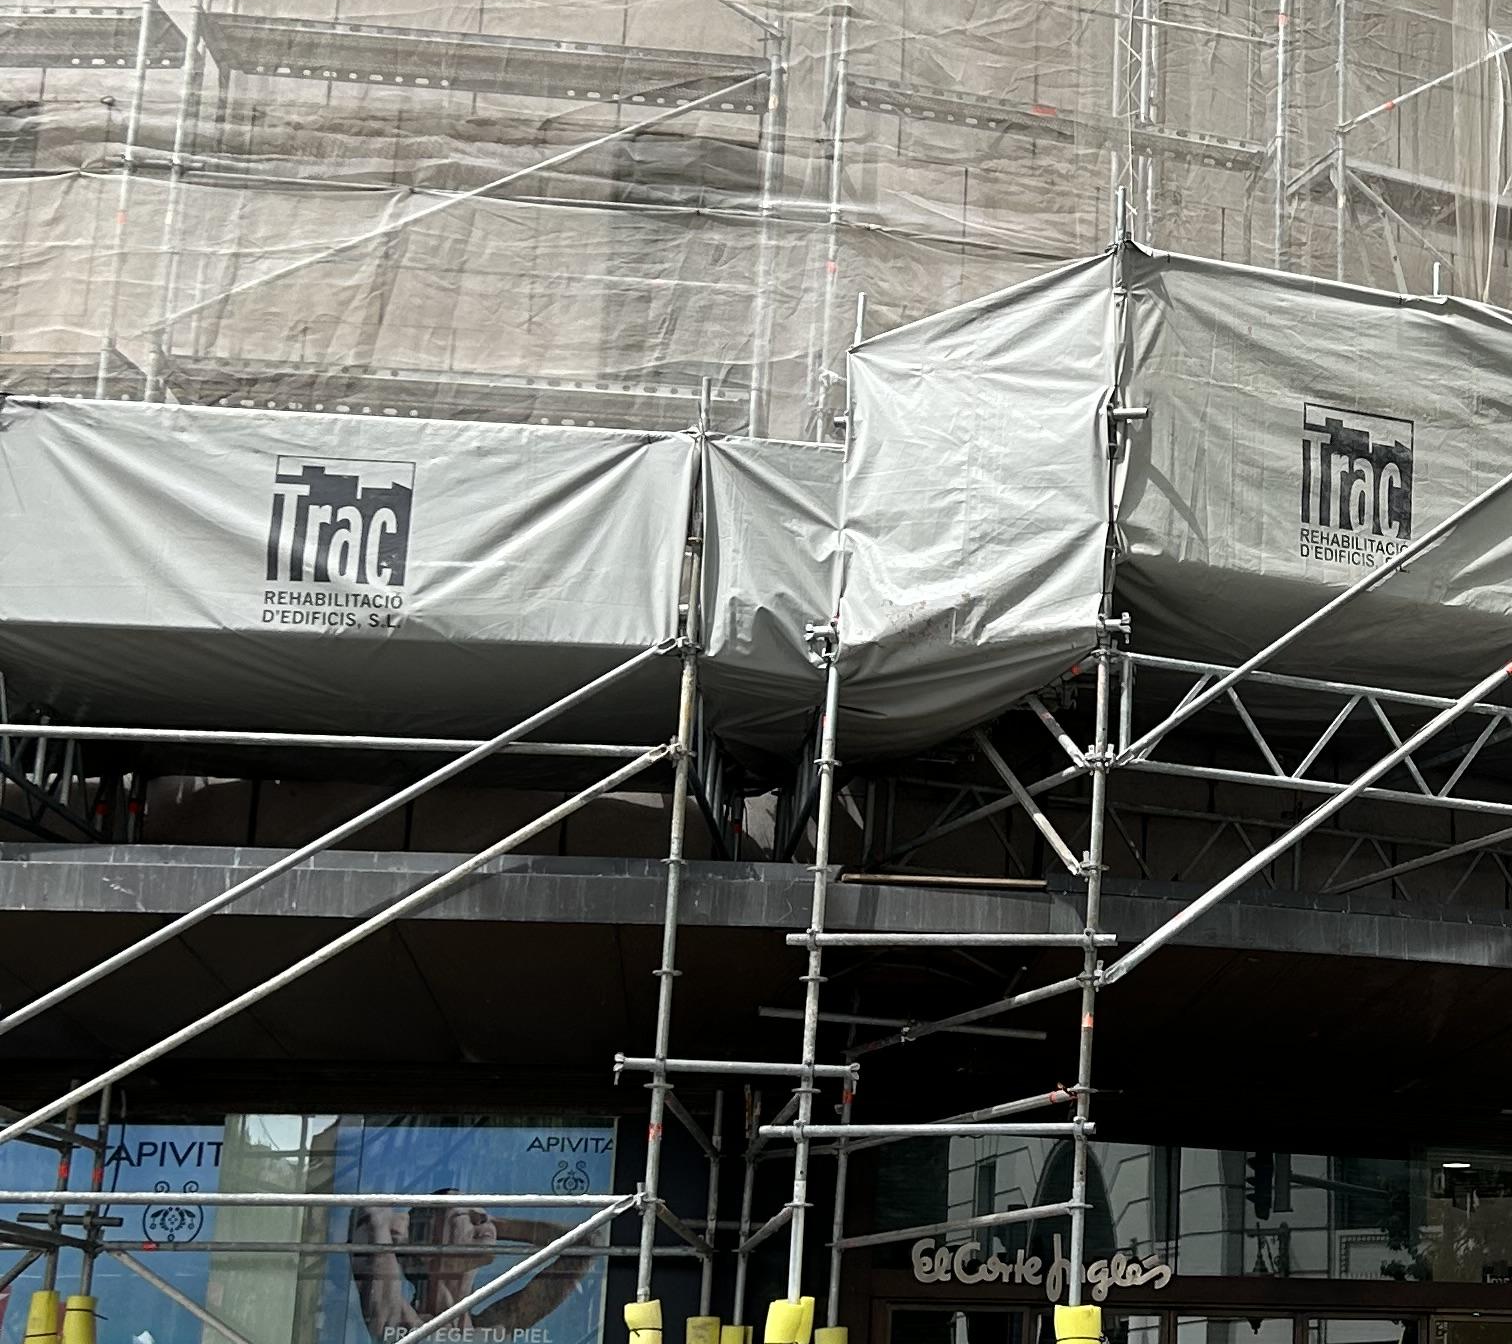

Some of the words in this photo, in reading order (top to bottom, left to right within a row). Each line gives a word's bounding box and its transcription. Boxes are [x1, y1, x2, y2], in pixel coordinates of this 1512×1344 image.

[1302, 428, 1403, 540] Trac
[272, 481, 400, 587] Trac
[263, 590, 404, 610] REHABILITACIÓ
[262, 609, 362, 630] D'EDIFICIS,
[368, 613, 402, 629] S.L.
[911, 1237, 952, 1284] El
[953, 1241, 1043, 1285] Corte
[384, 1326, 474, 1343] PREGE
[481, 1327, 506, 1343] TU
[512, 1327, 553, 1344] PIEL
